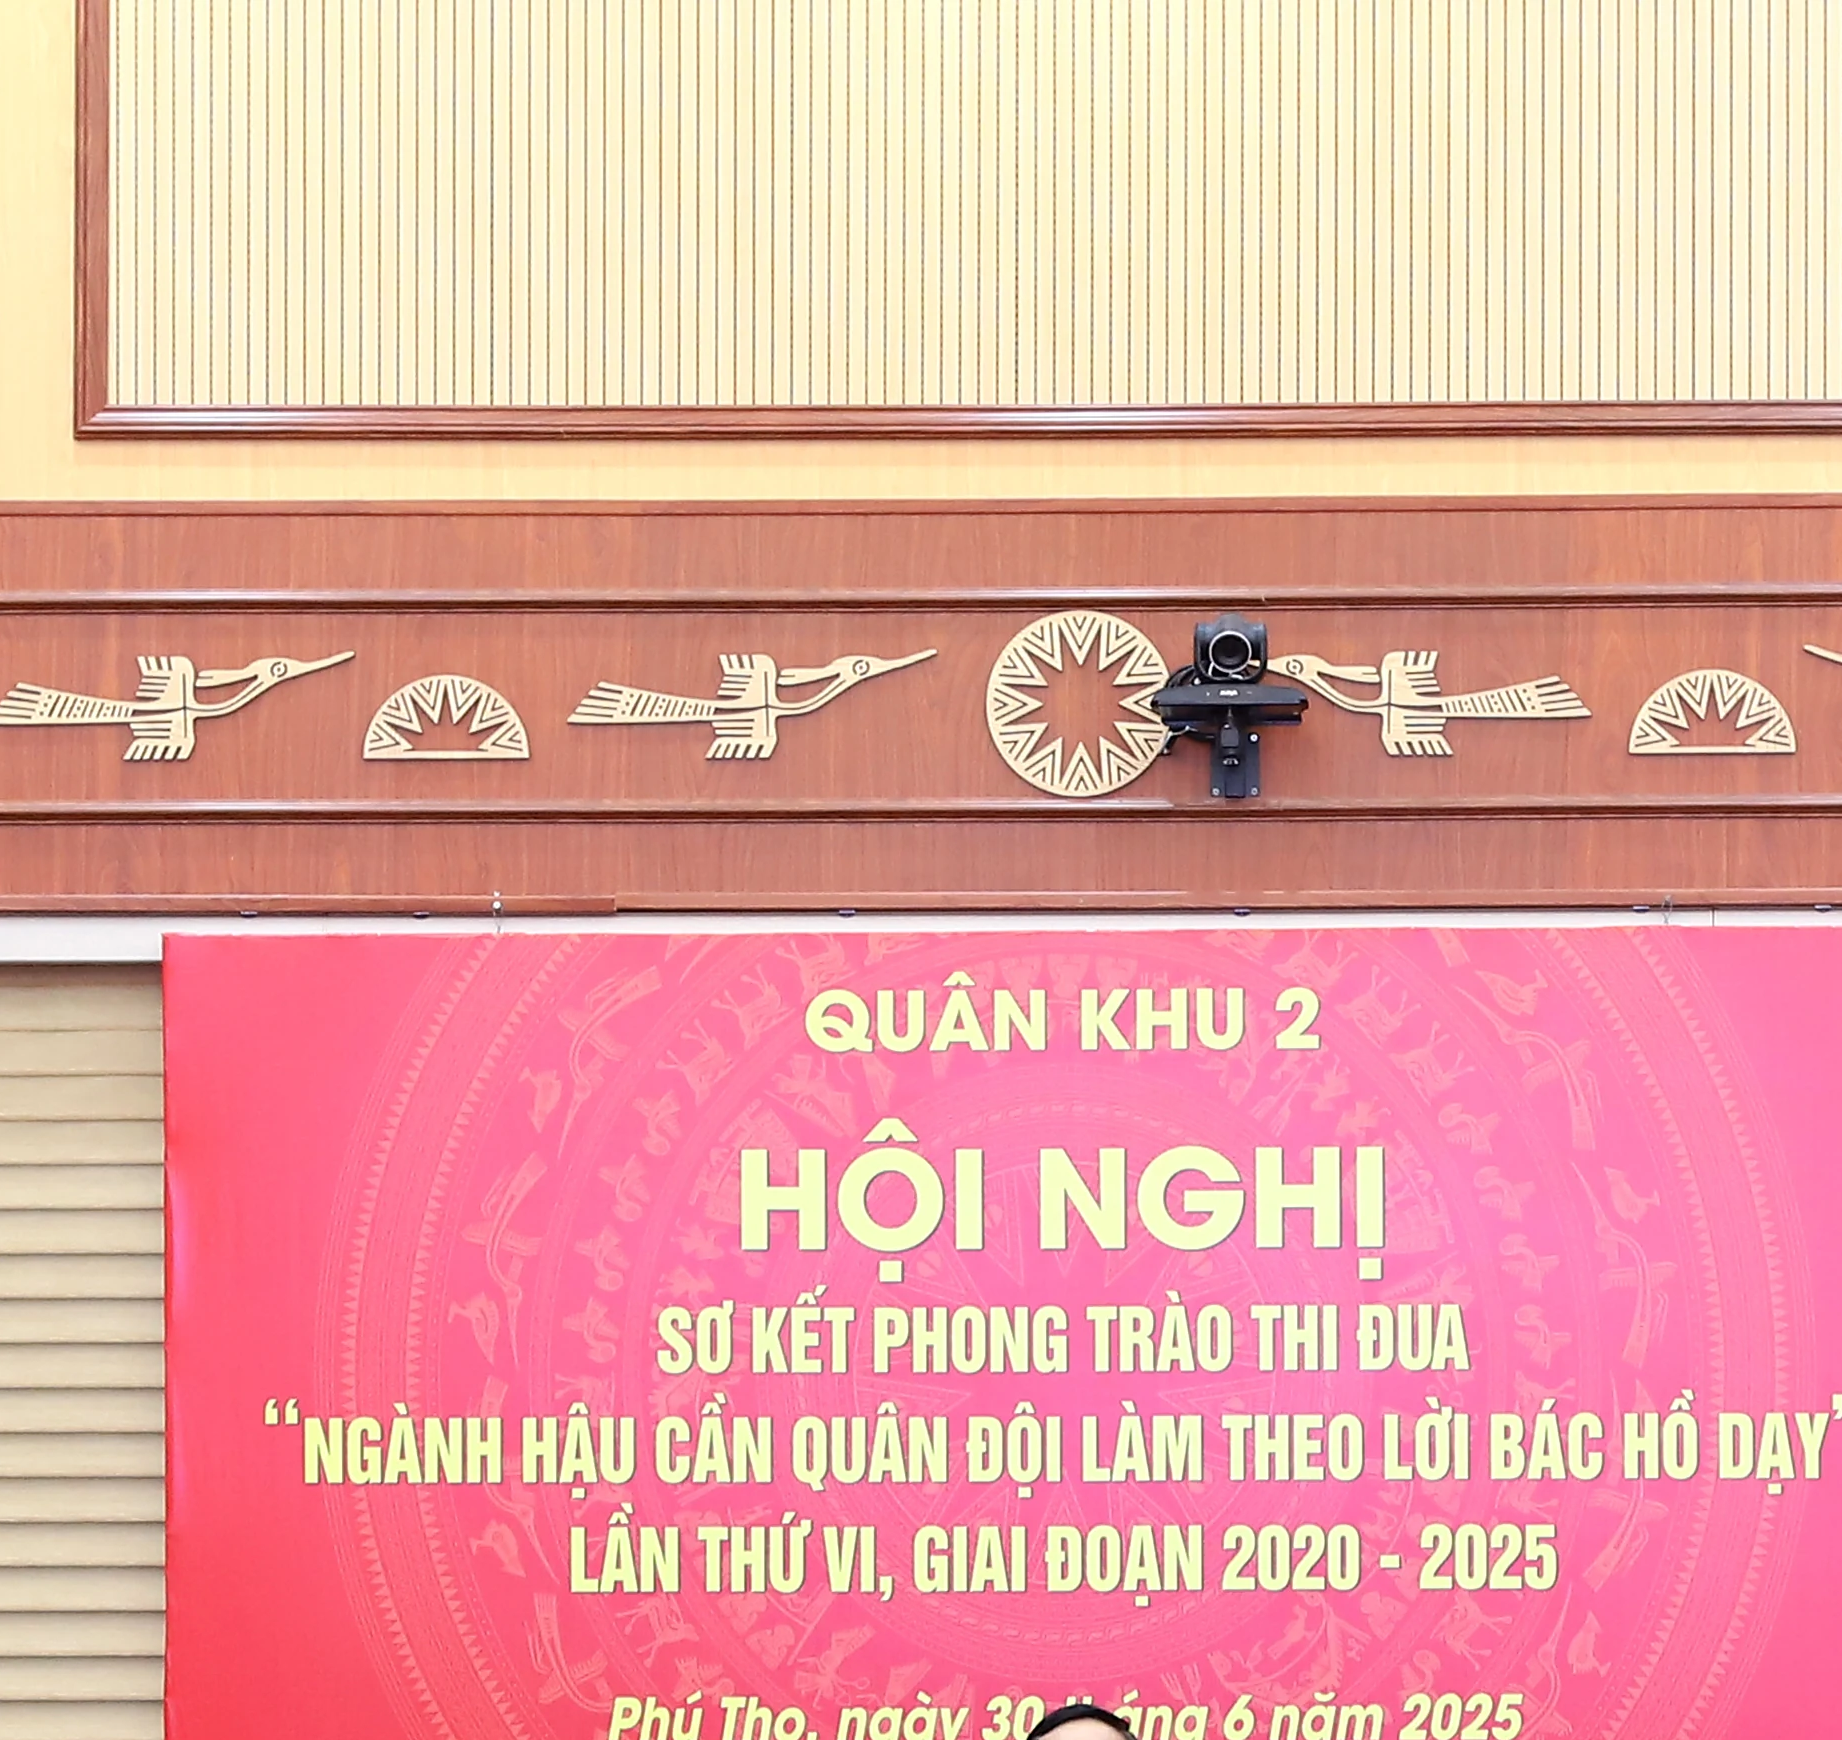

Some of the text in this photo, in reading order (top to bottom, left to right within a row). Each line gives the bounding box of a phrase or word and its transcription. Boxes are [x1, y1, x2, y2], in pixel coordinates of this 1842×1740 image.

[803, 969, 1321, 1054] QUÂN KHU 2
[739, 1116, 1385, 1284] HỘI NGHỊ
[656, 1286, 1471, 1375] SƠ KẾT PHONG TRÀO THI ĐUA
[521, 1400, 636, 1500] HẬU
[654, 1391, 773, 1485] CẦN
[791, 1400, 948, 1492] QUÂN
[964, 1400, 1062, 1499] ĐỘI
[1081, 1399, 1204, 1483] LÀM
[1220, 1412, 1364, 1482] THEO
[1382, 1395, 1470, 1482] LỜI
[1489, 1397, 1604, 1482] BÁC
[1622, 1387, 1699, 1481] HỒ
[569, 1502, 680, 1594] LẦN
[696, 1510, 813, 1595] THỨ
[822, 1525, 894, 1602] VI,
[912, 1524, 1027, 1594] GIAI
[1043, 1523, 1204, 1608] ĐOẠN
[1220, 1522, 1361, 1592] 2020
[1418, 1521, 1558, 1592] 2025
